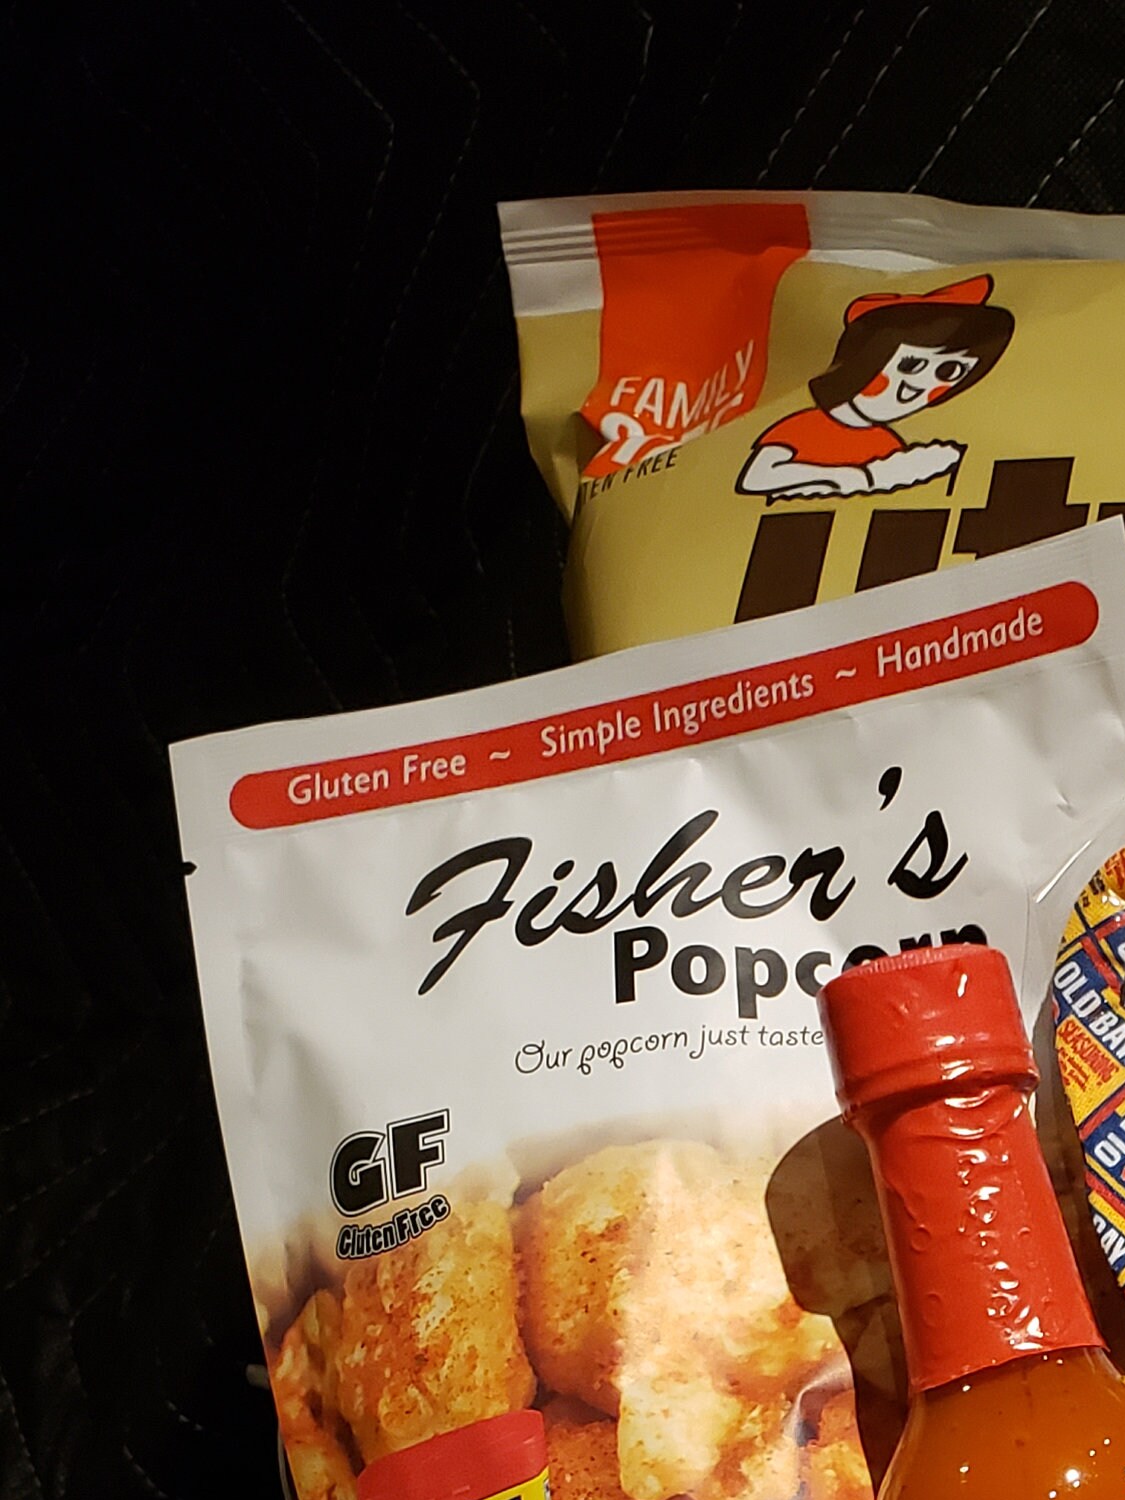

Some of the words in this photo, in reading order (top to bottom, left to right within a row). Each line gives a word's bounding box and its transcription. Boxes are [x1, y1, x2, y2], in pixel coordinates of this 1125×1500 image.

[610, 339, 754, 429] FAMILY
[287, 767, 391, 807] Gluten
[403, 753, 468, 787] Free
[540, 709, 642, 758] Simple
[653, 671, 815, 735] Ingredients
[877, 606, 1044, 679] Handmade
[405, 766, 969, 996] Fisher's
[1053, 960, 1102, 1018] OLD
[515, 1039, 573, 1074] Our
[577, 1031, 688, 1075] popcorn
[690, 1024, 750, 1060] just
[330, 1108, 450, 1218] GF
